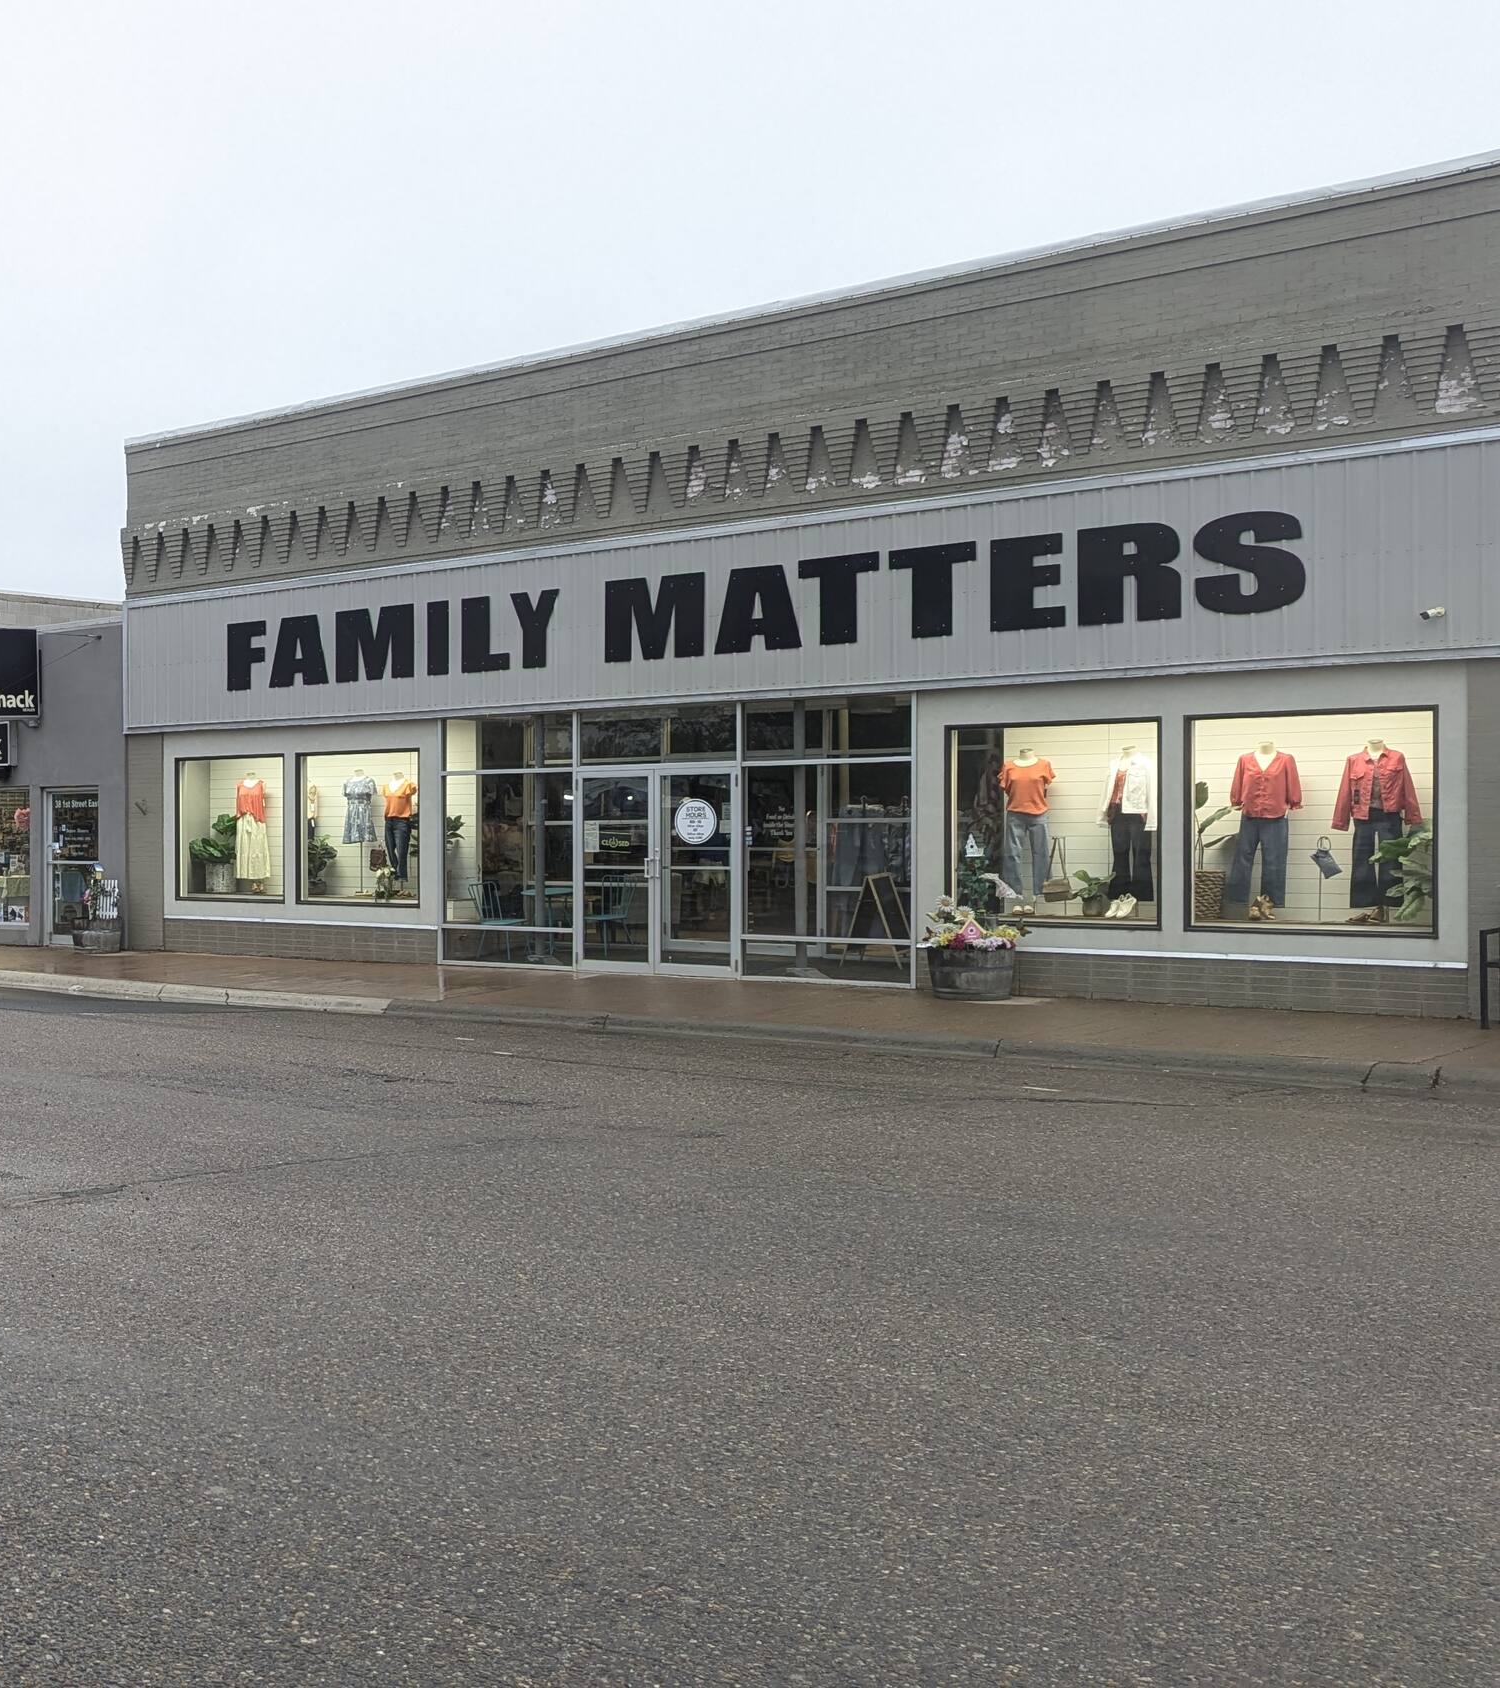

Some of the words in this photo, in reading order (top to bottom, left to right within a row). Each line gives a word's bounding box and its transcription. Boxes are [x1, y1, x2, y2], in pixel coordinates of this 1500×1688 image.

[227, 589, 560, 691] FAMILY
[605, 511, 1306, 663] MATTERS
[71, 800, 87, 808] Street
